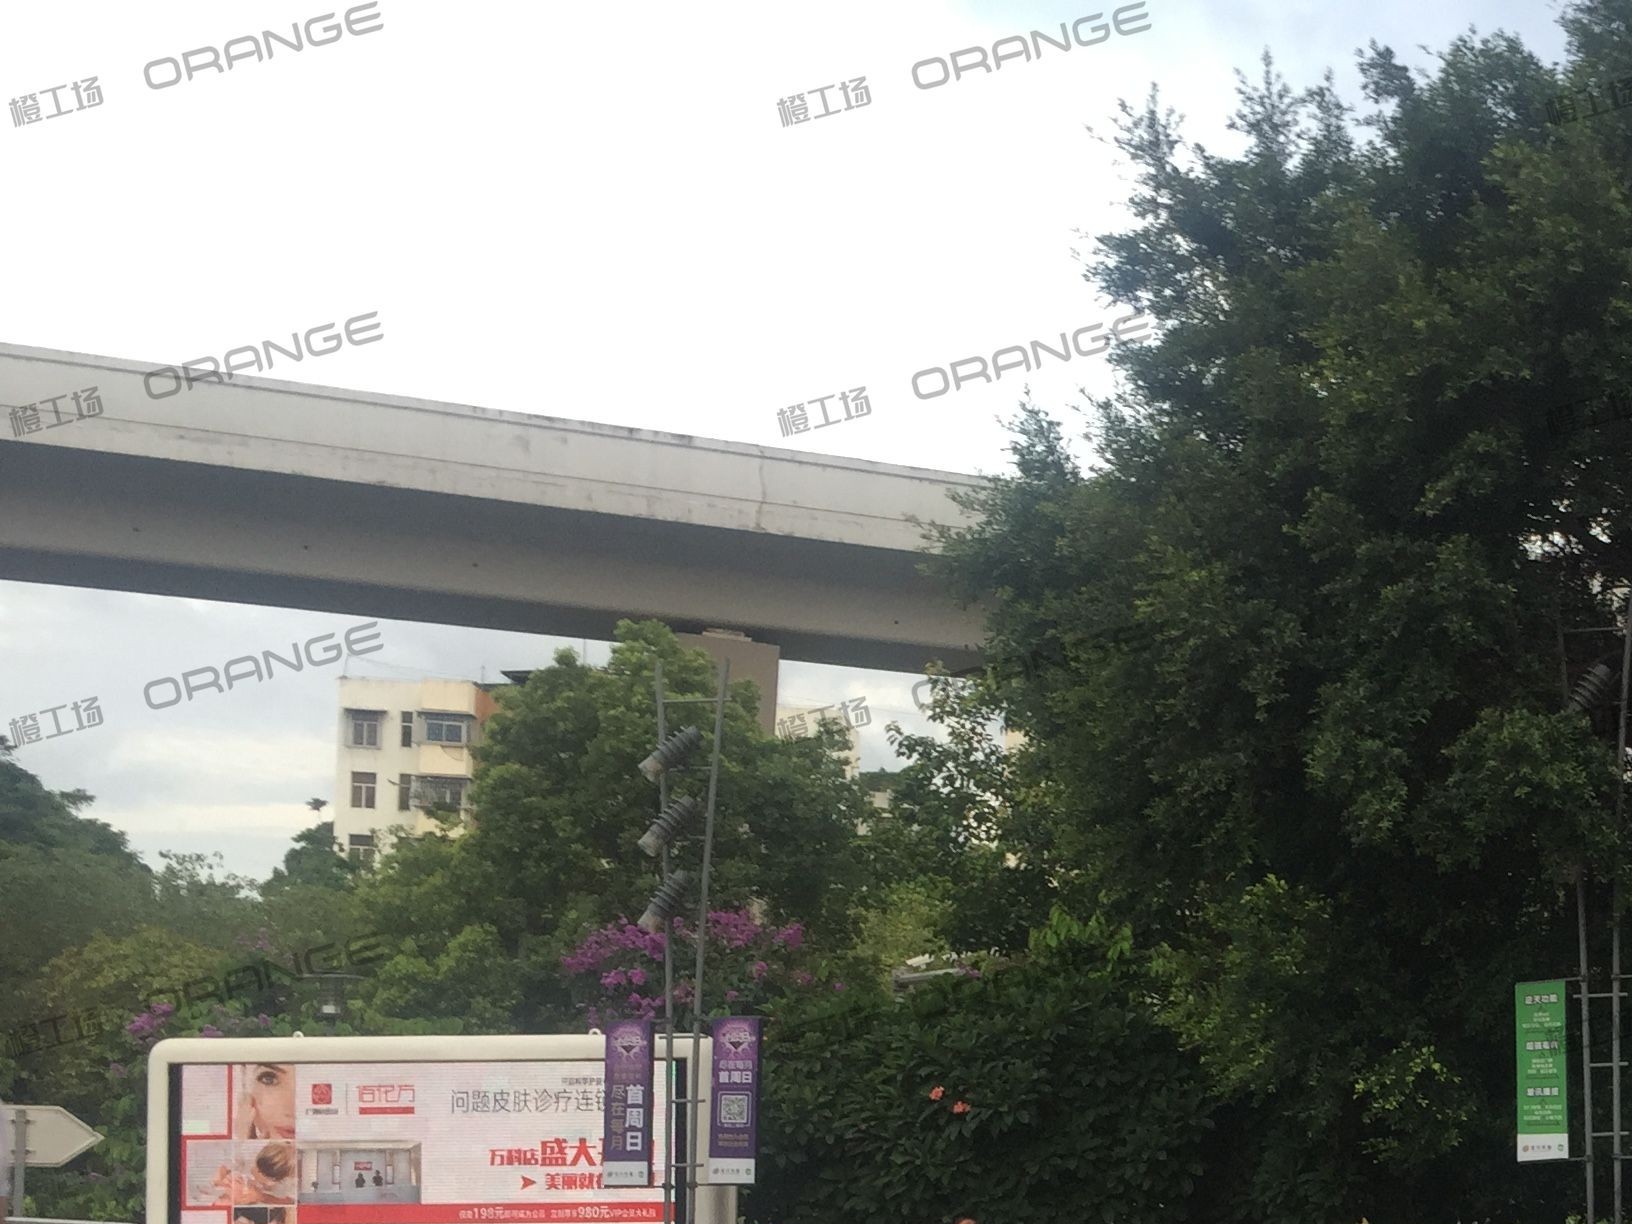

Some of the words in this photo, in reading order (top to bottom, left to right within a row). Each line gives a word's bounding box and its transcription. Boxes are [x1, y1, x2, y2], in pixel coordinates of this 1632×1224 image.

[718, 1071, 753, 1084] 首周日
[625, 1084, 645, 1151] 首周日
